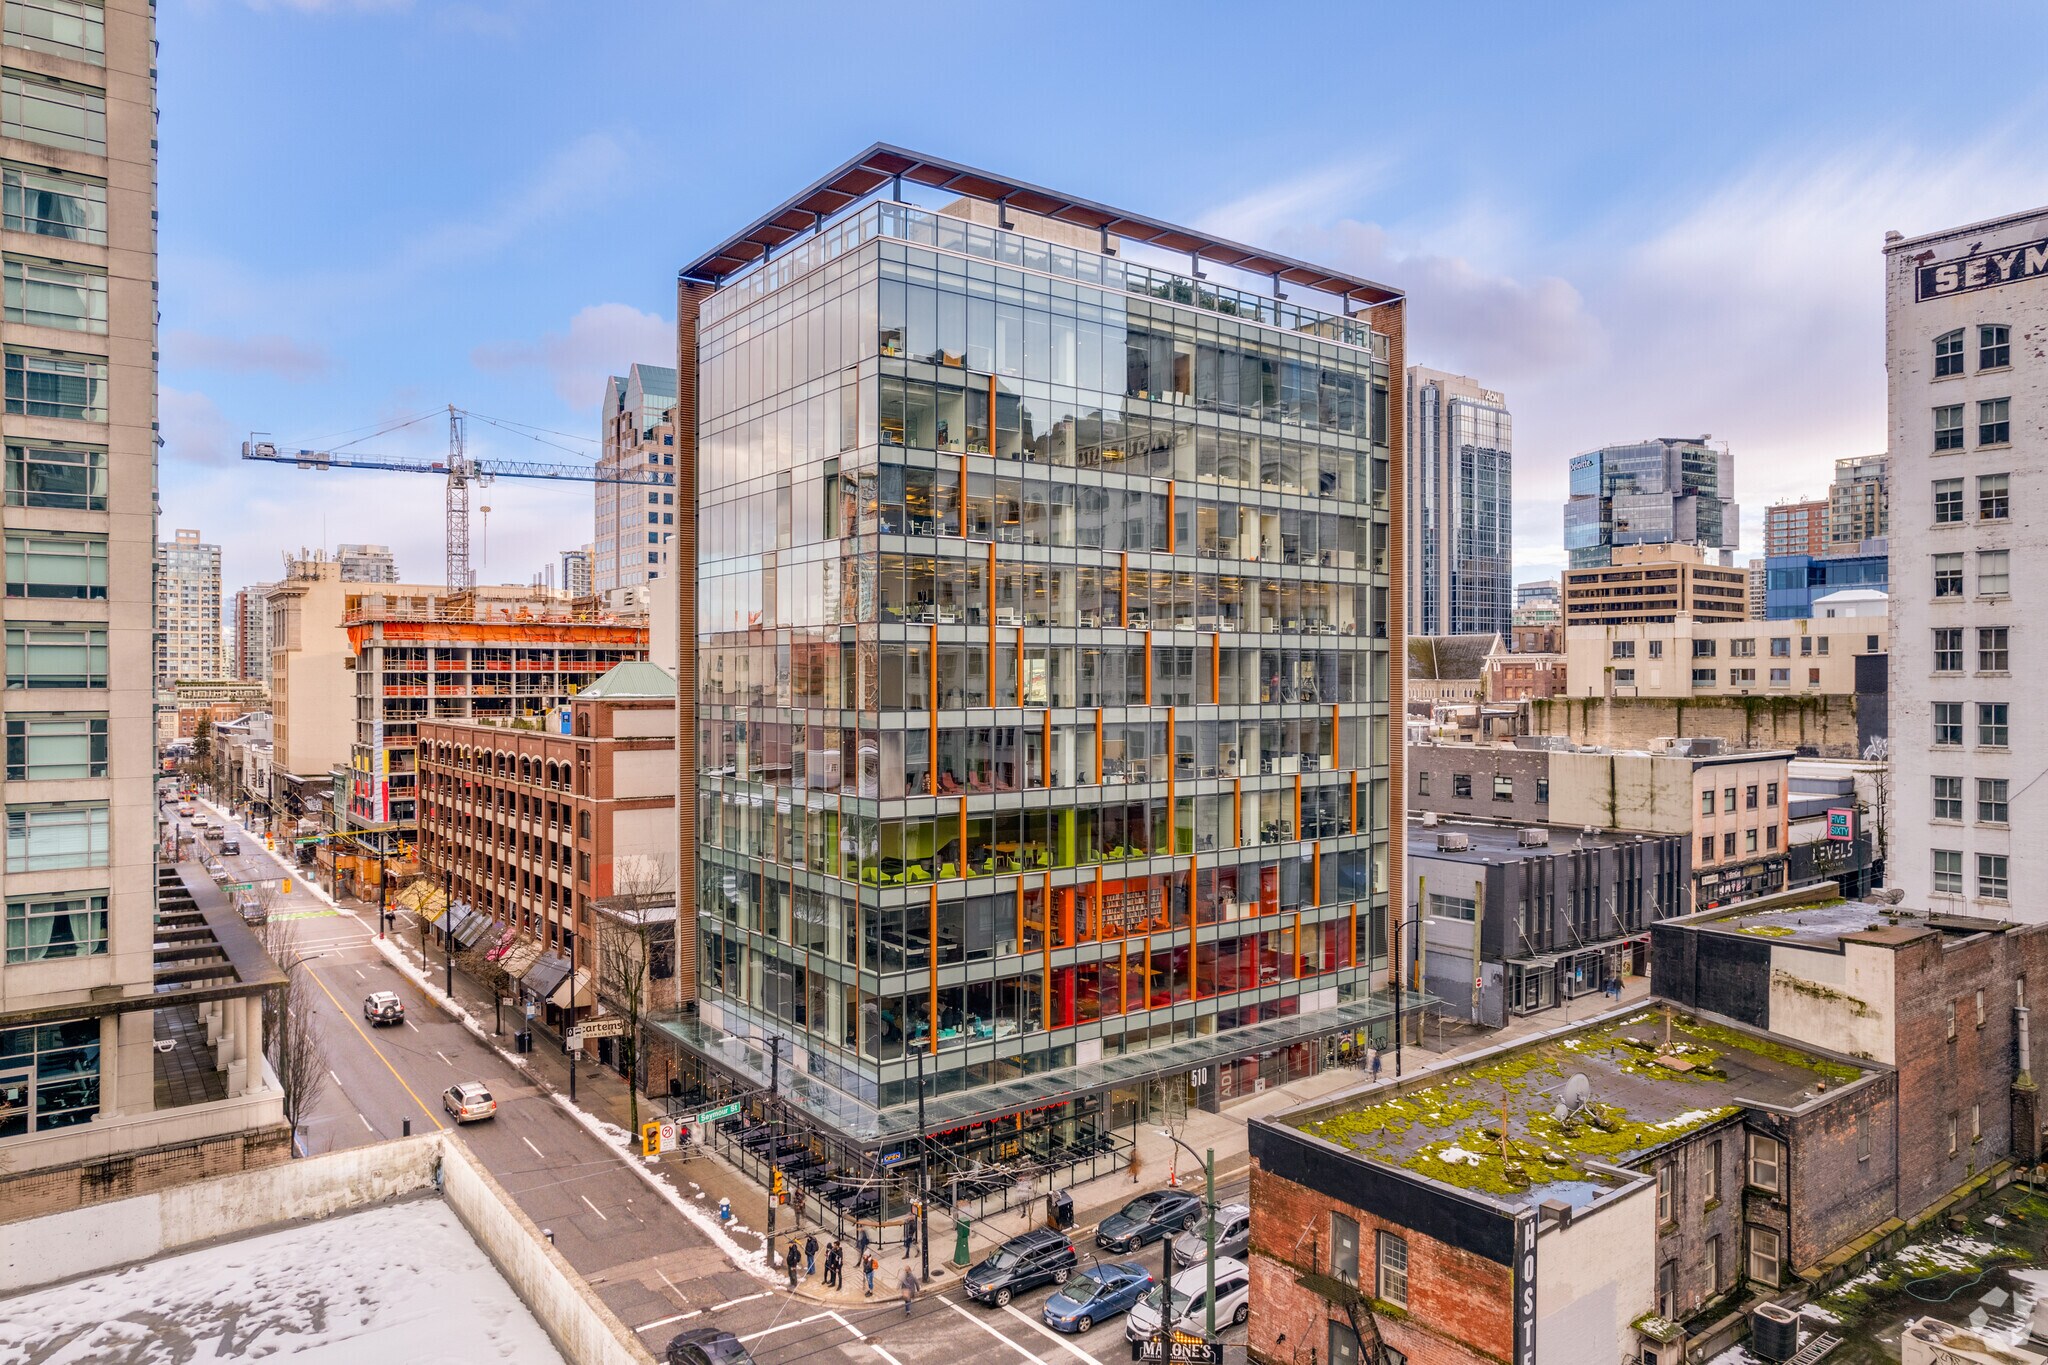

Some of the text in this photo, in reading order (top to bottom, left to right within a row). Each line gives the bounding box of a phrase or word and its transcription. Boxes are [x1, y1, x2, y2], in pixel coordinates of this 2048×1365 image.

[1935, 243, 2048, 292] SEYM
[1485, 390, 1500, 403] AON
[1831, 815, 1846, 824] FIVE
[1831, 826, 1849, 836] SIXTY
[1812, 841, 1853, 862] LEVELS
[1191, 1067, 1207, 1087] 510
[1221, 1060, 1232, 1096] ADL
[701, 1103, 738, 1122] Seymour St
[886, 1153, 900, 1161] OPEN
[1143, 1341, 1211, 1358] MAONE'S
